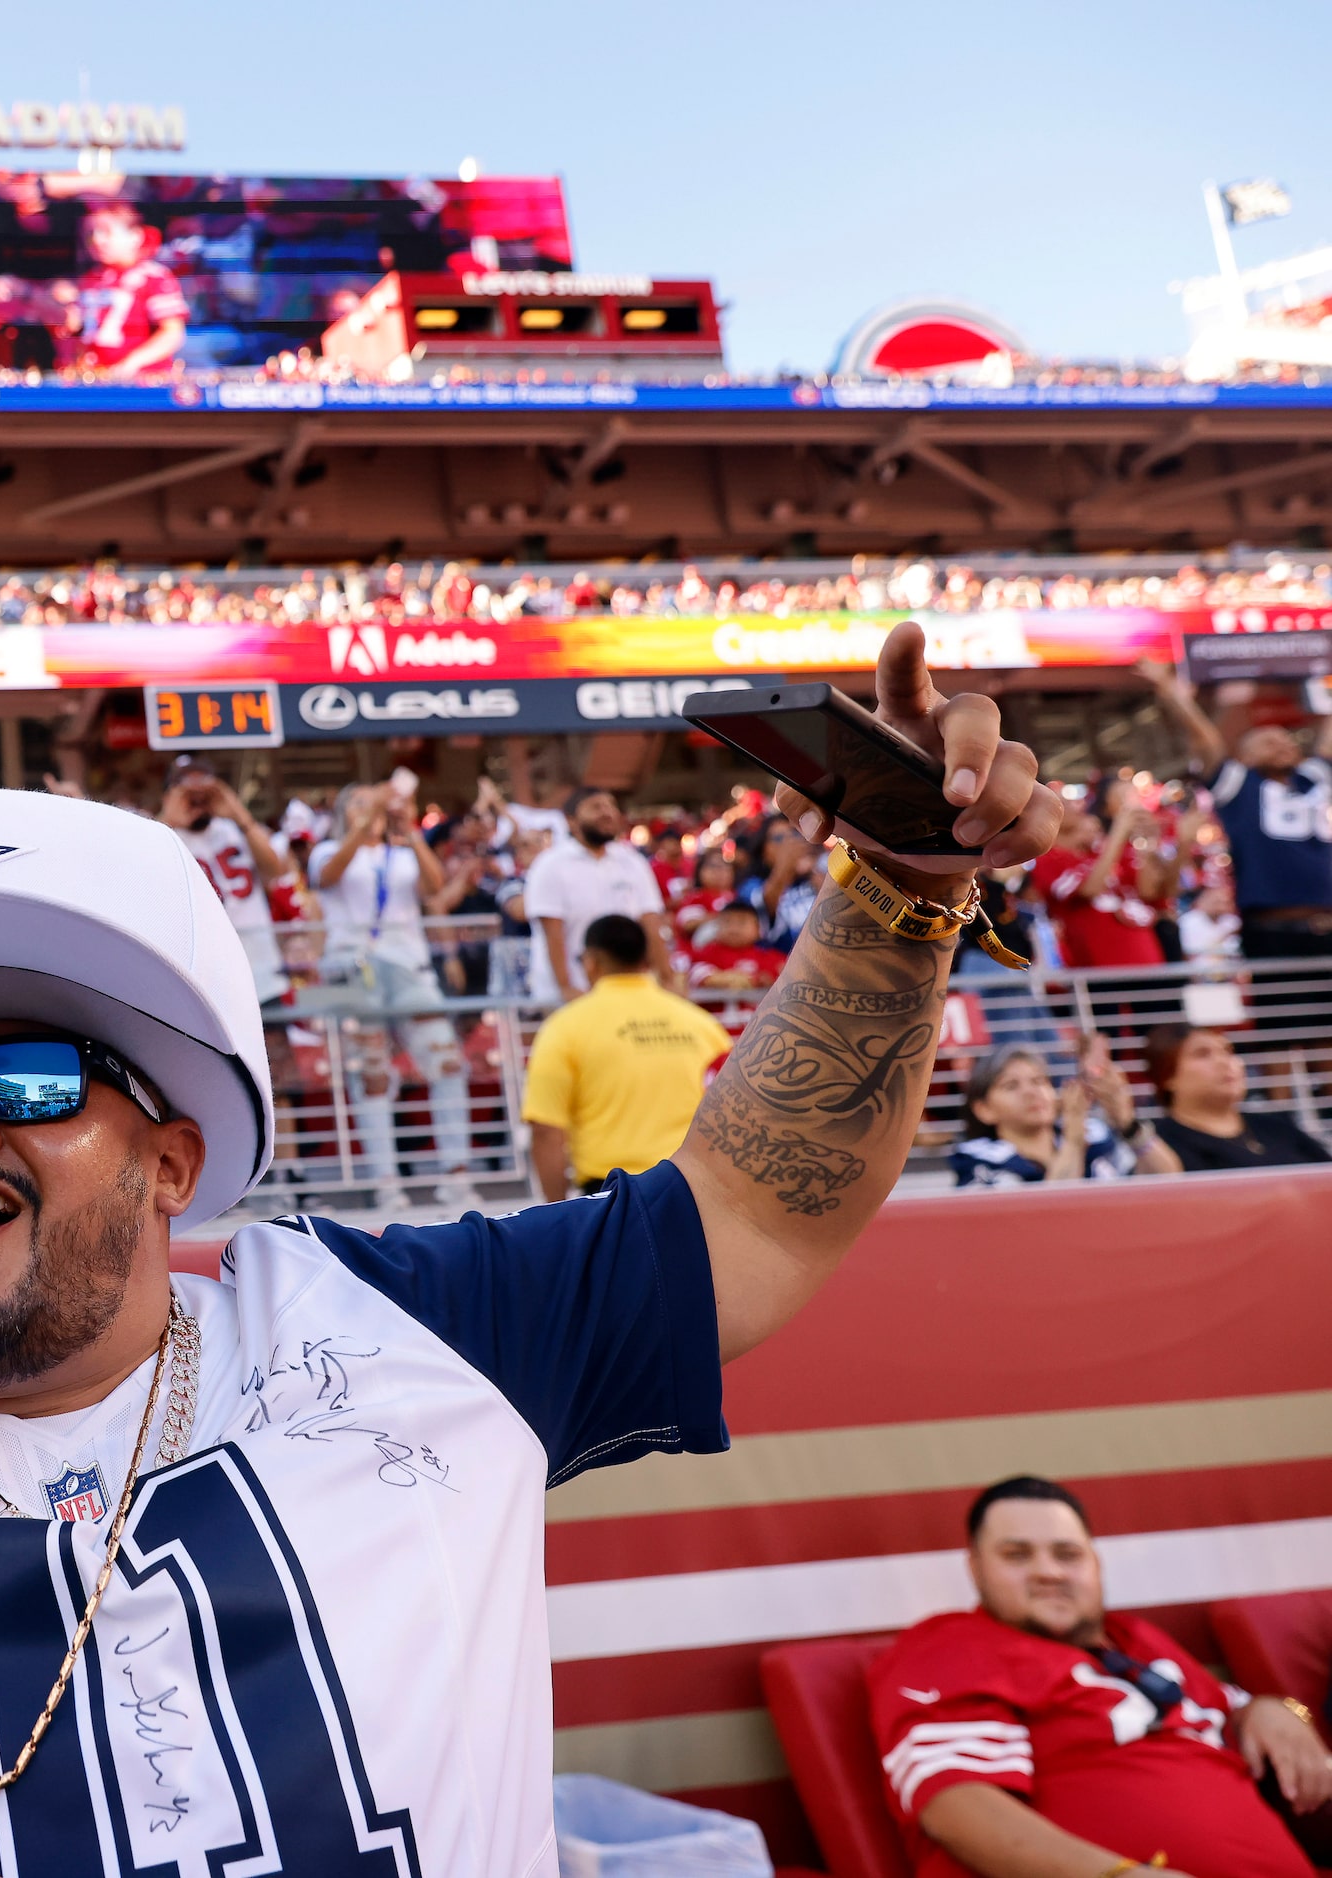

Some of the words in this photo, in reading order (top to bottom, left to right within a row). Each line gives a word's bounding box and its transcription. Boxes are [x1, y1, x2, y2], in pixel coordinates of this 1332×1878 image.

[393, 628, 498, 669] Adobe
[358, 688, 520, 722] LEXUS
[854, 874, 896, 915] 10/8/23
[897, 912, 933, 937] CACHE
[56, 1492, 104, 1522] NFL
